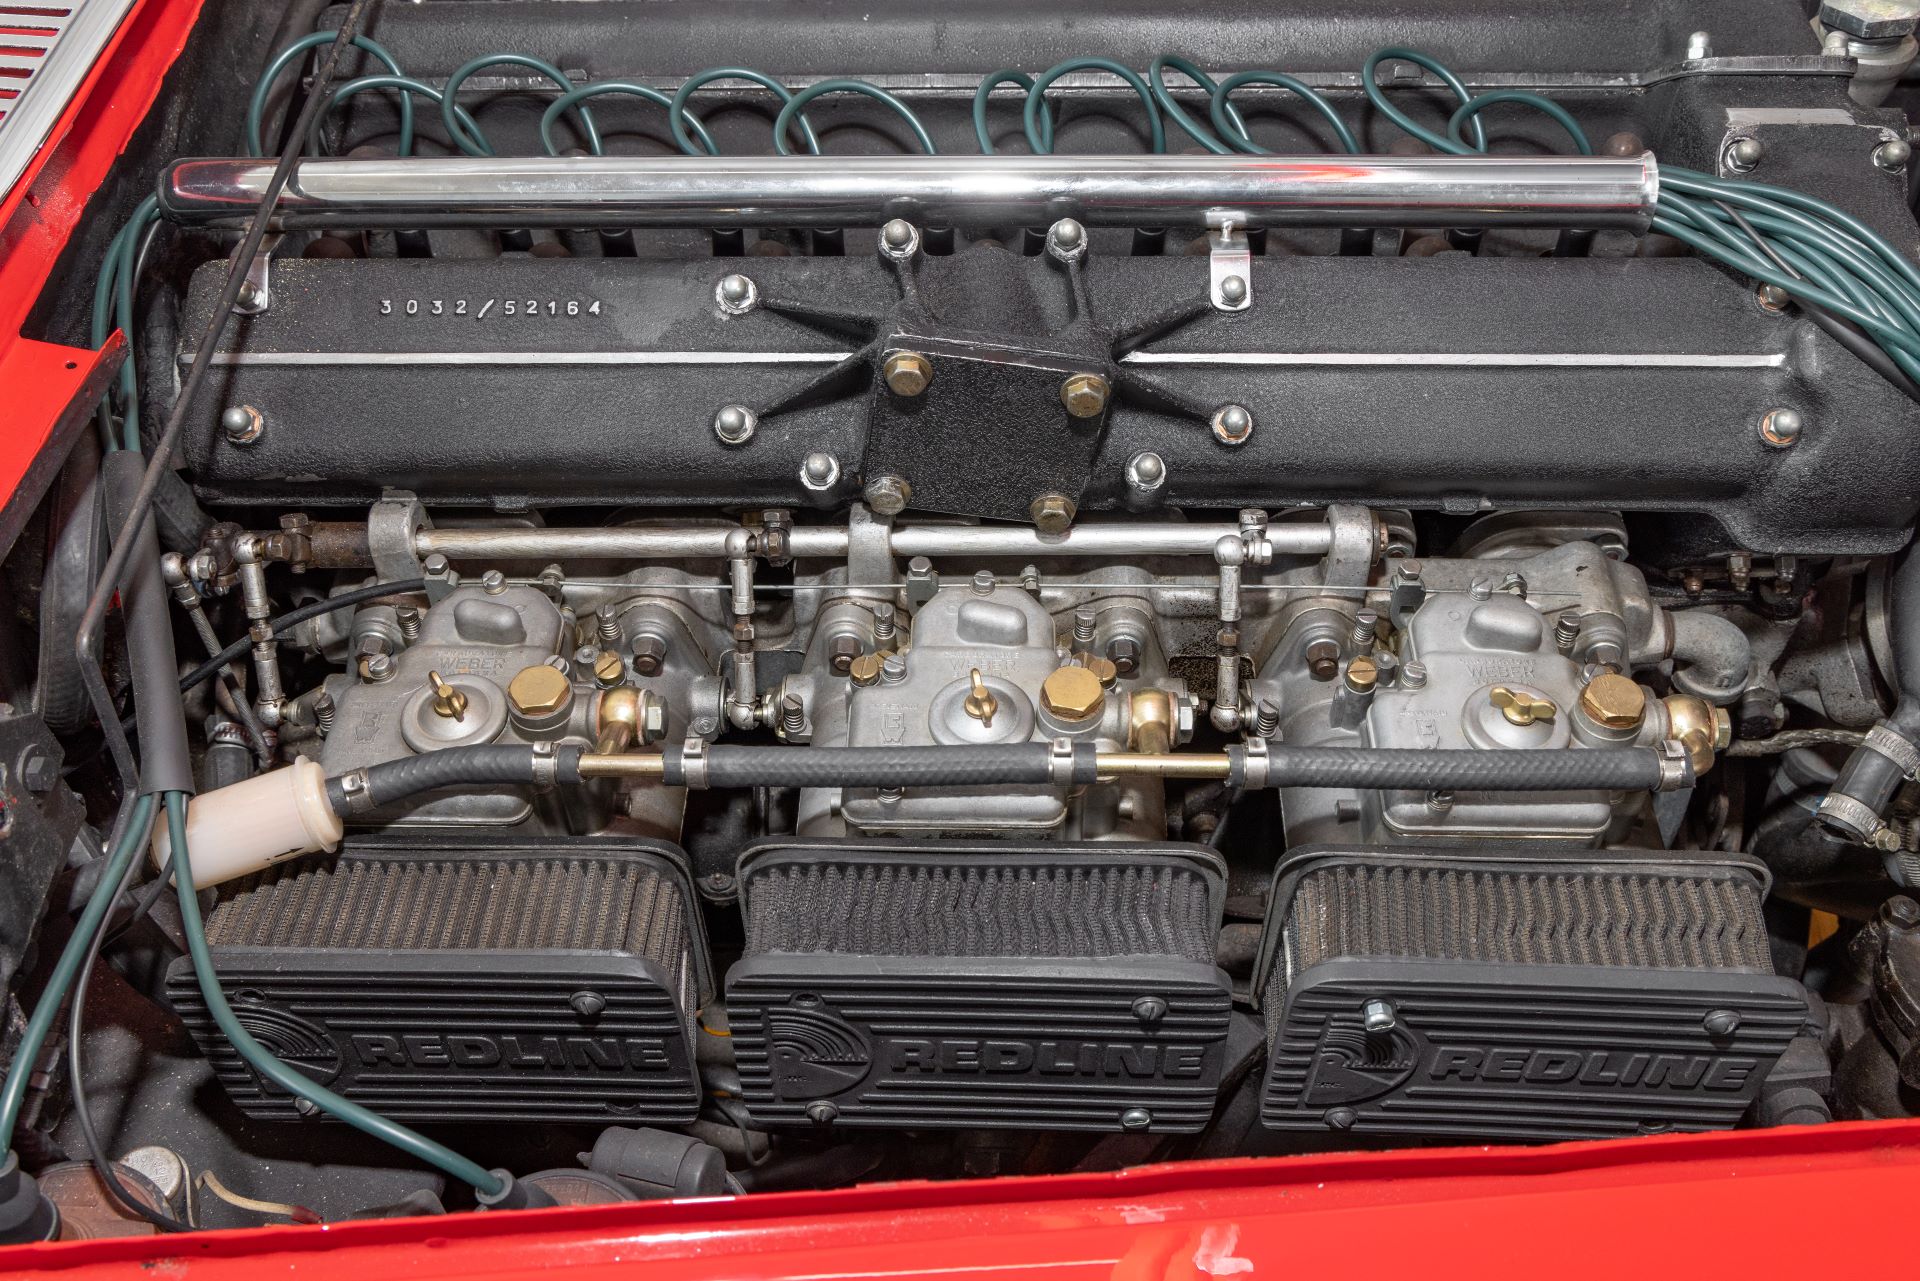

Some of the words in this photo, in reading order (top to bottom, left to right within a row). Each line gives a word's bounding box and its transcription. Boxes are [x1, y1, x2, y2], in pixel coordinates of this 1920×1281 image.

[379, 298, 602, 319] 3032/52164
[439, 657, 506, 671] WEBER
[950, 658, 1017, 672] WEBER
[1465, 666, 1536, 679] WEBER
[350, 1034, 670, 1068] REDLINE
[889, 1038, 1206, 1079] REDLINE
[1428, 1046, 1757, 1091] REDLINE
